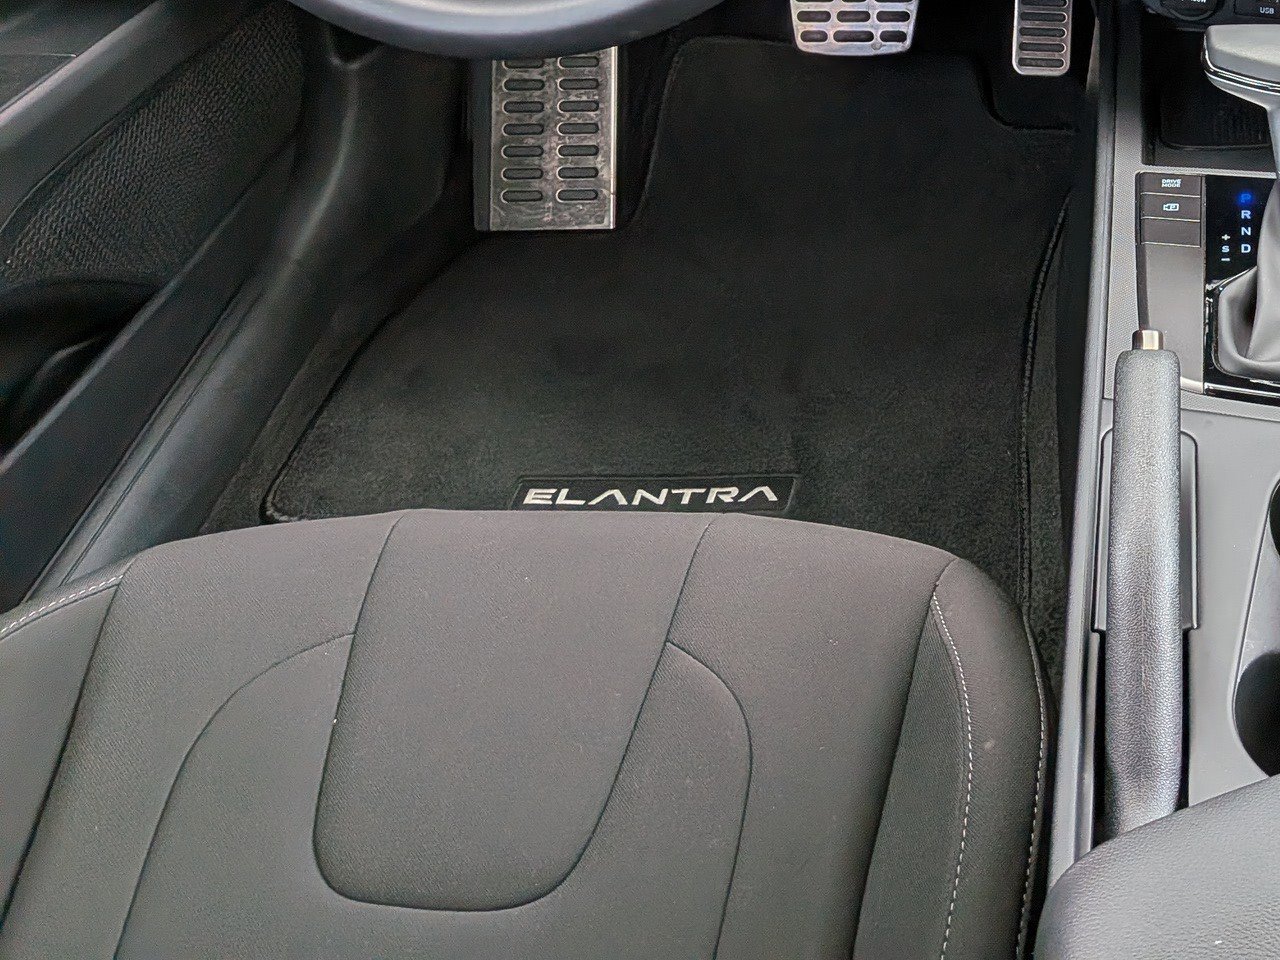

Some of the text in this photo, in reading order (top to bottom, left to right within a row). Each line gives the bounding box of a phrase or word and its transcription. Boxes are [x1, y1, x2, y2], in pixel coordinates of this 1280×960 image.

[1259, 6, 1275, 15] USB
[1241, 193, 1251, 203] P
[1241, 210, 1251, 219] R
[1241, 227, 1251, 236] N
[1221, 245, 1230, 253] S
[1241, 244, 1251, 253] D
[523, 486, 778, 505] ELANTRA
